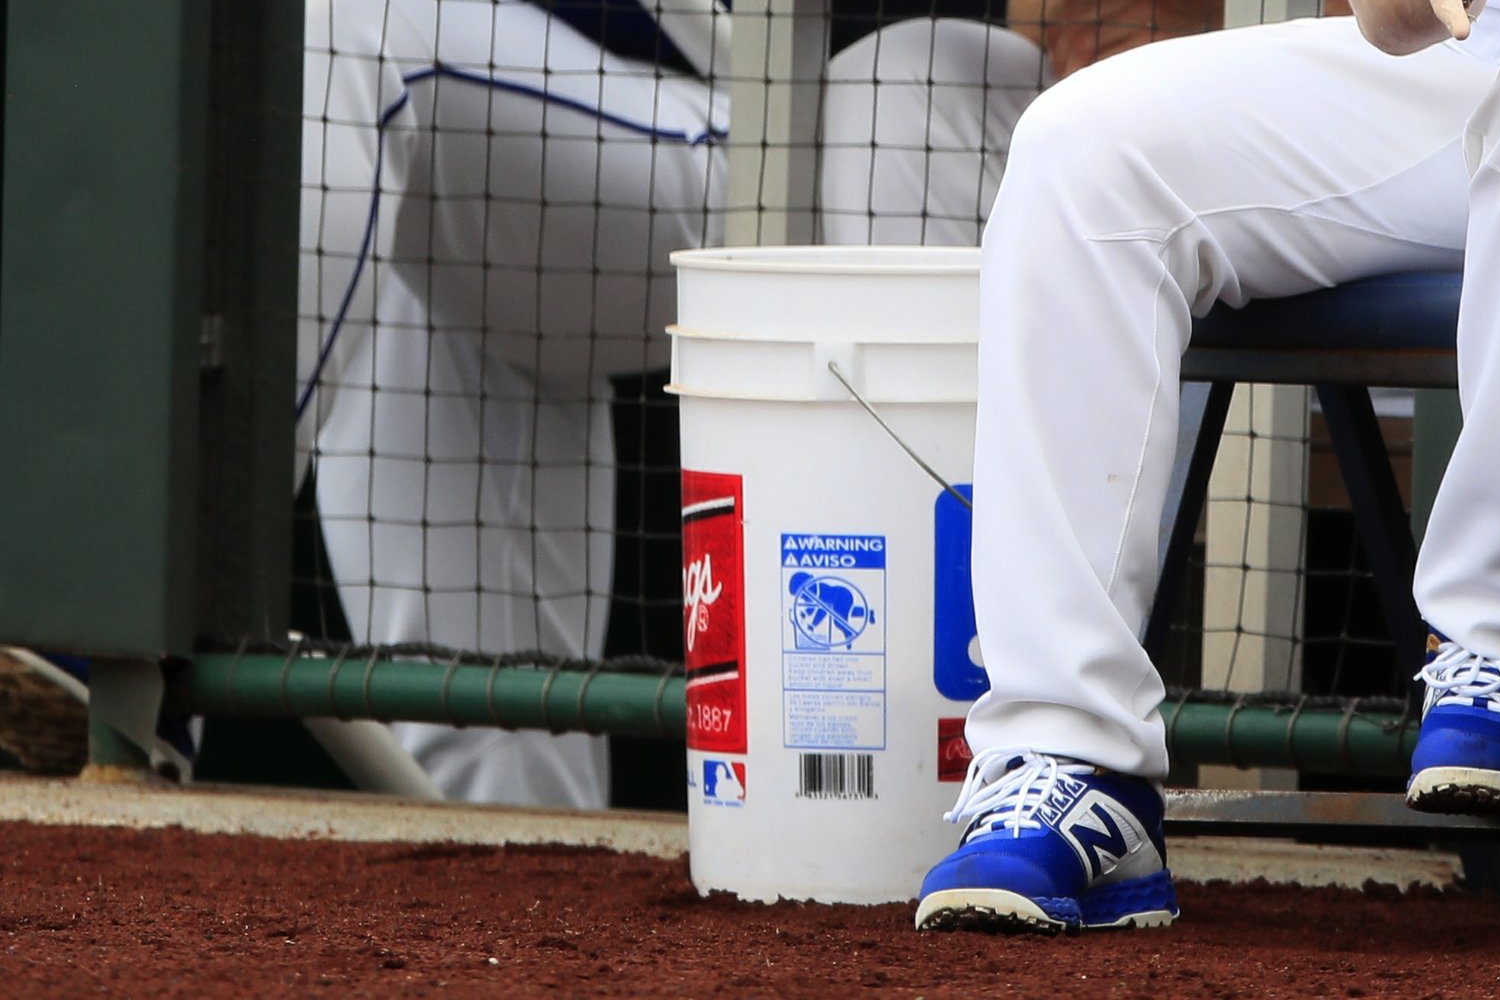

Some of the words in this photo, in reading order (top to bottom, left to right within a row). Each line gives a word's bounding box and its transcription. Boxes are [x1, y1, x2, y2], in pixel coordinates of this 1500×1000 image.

[798, 537, 884, 552] WARNING
[800, 554, 857, 568] AVISO
[697, 704, 732, 732] 1887
